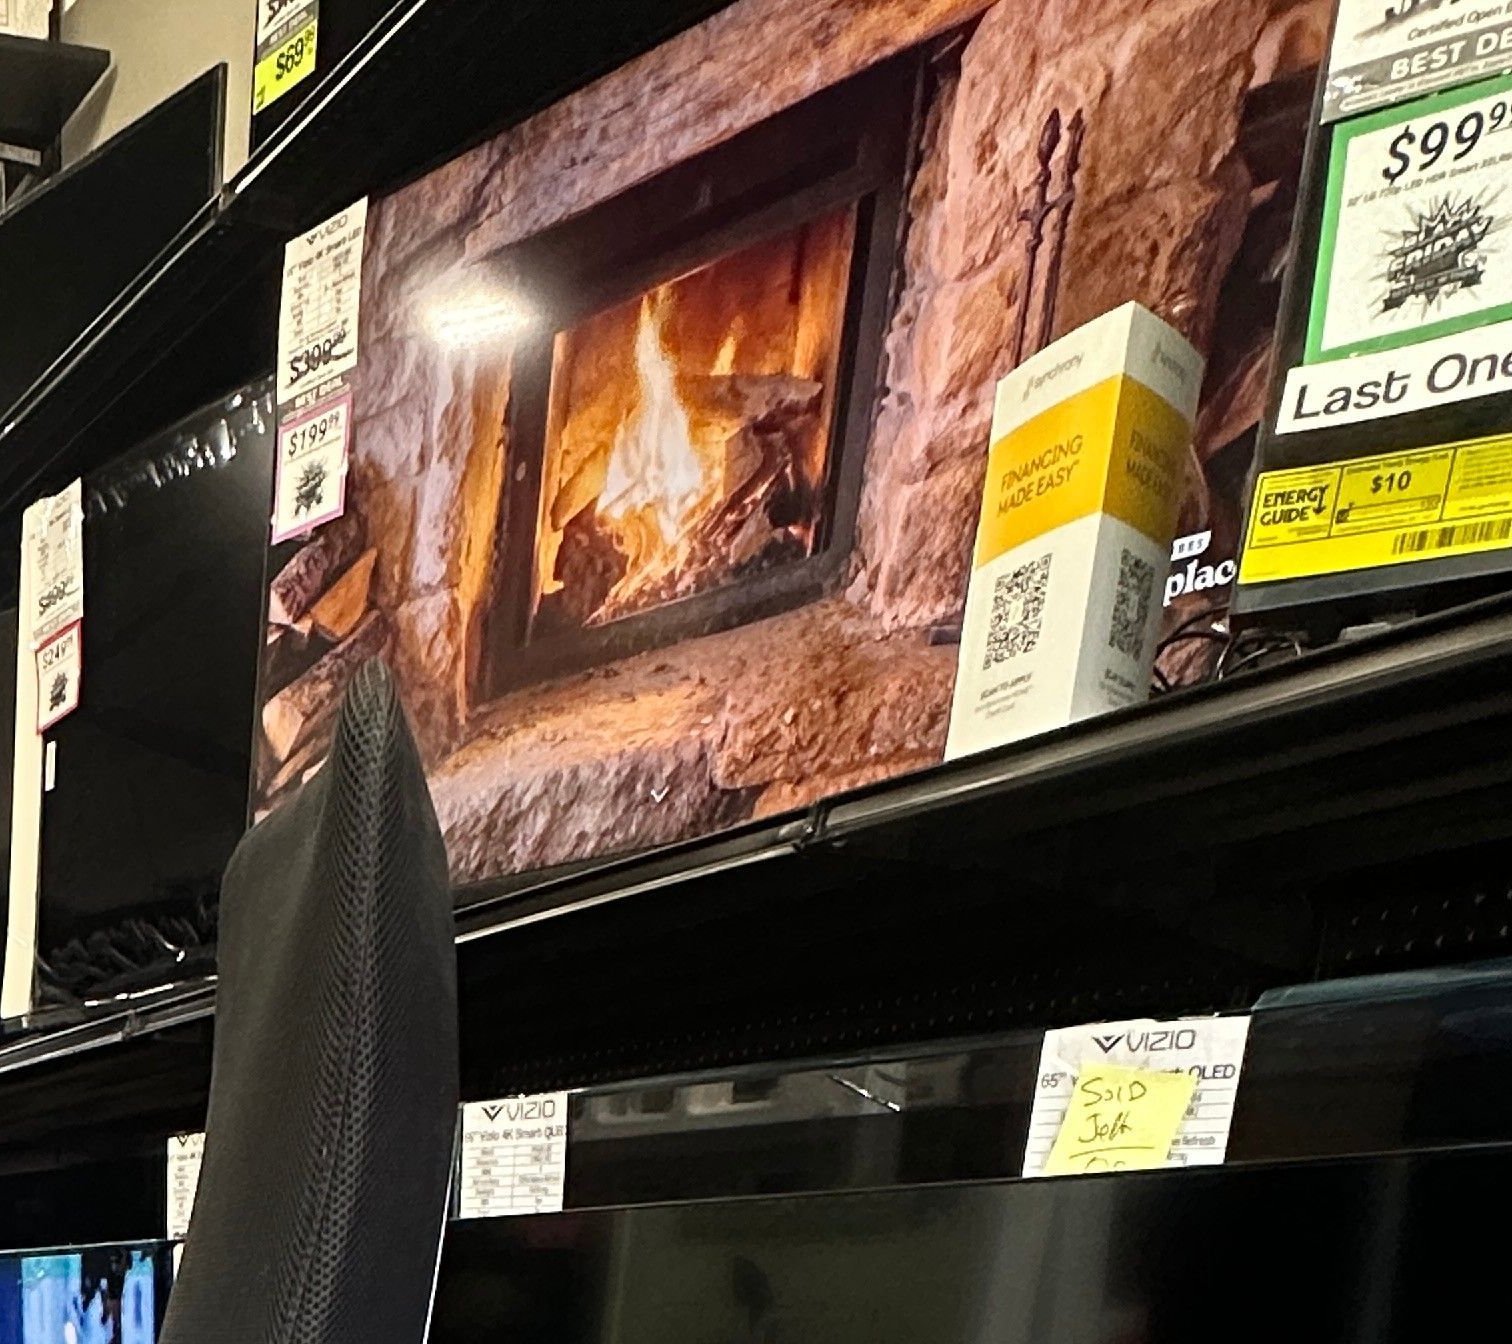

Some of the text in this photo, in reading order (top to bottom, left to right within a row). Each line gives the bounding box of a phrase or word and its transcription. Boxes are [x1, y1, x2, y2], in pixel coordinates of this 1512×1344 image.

[1391, 39, 1469, 80] BEST
[1293, 352, 1512, 421] Last One
[999, 433, 1085, 492] FINANCING
[996, 465, 1074, 518] MADE EASY
[1369, 470, 1411, 494] $10
[1262, 485, 1330, 514] ENERGY
[1260, 505, 1311, 527] GUIDE
[1127, 1029, 1197, 1052] VIZIO
[506, 1100, 556, 1121] VIZIO
